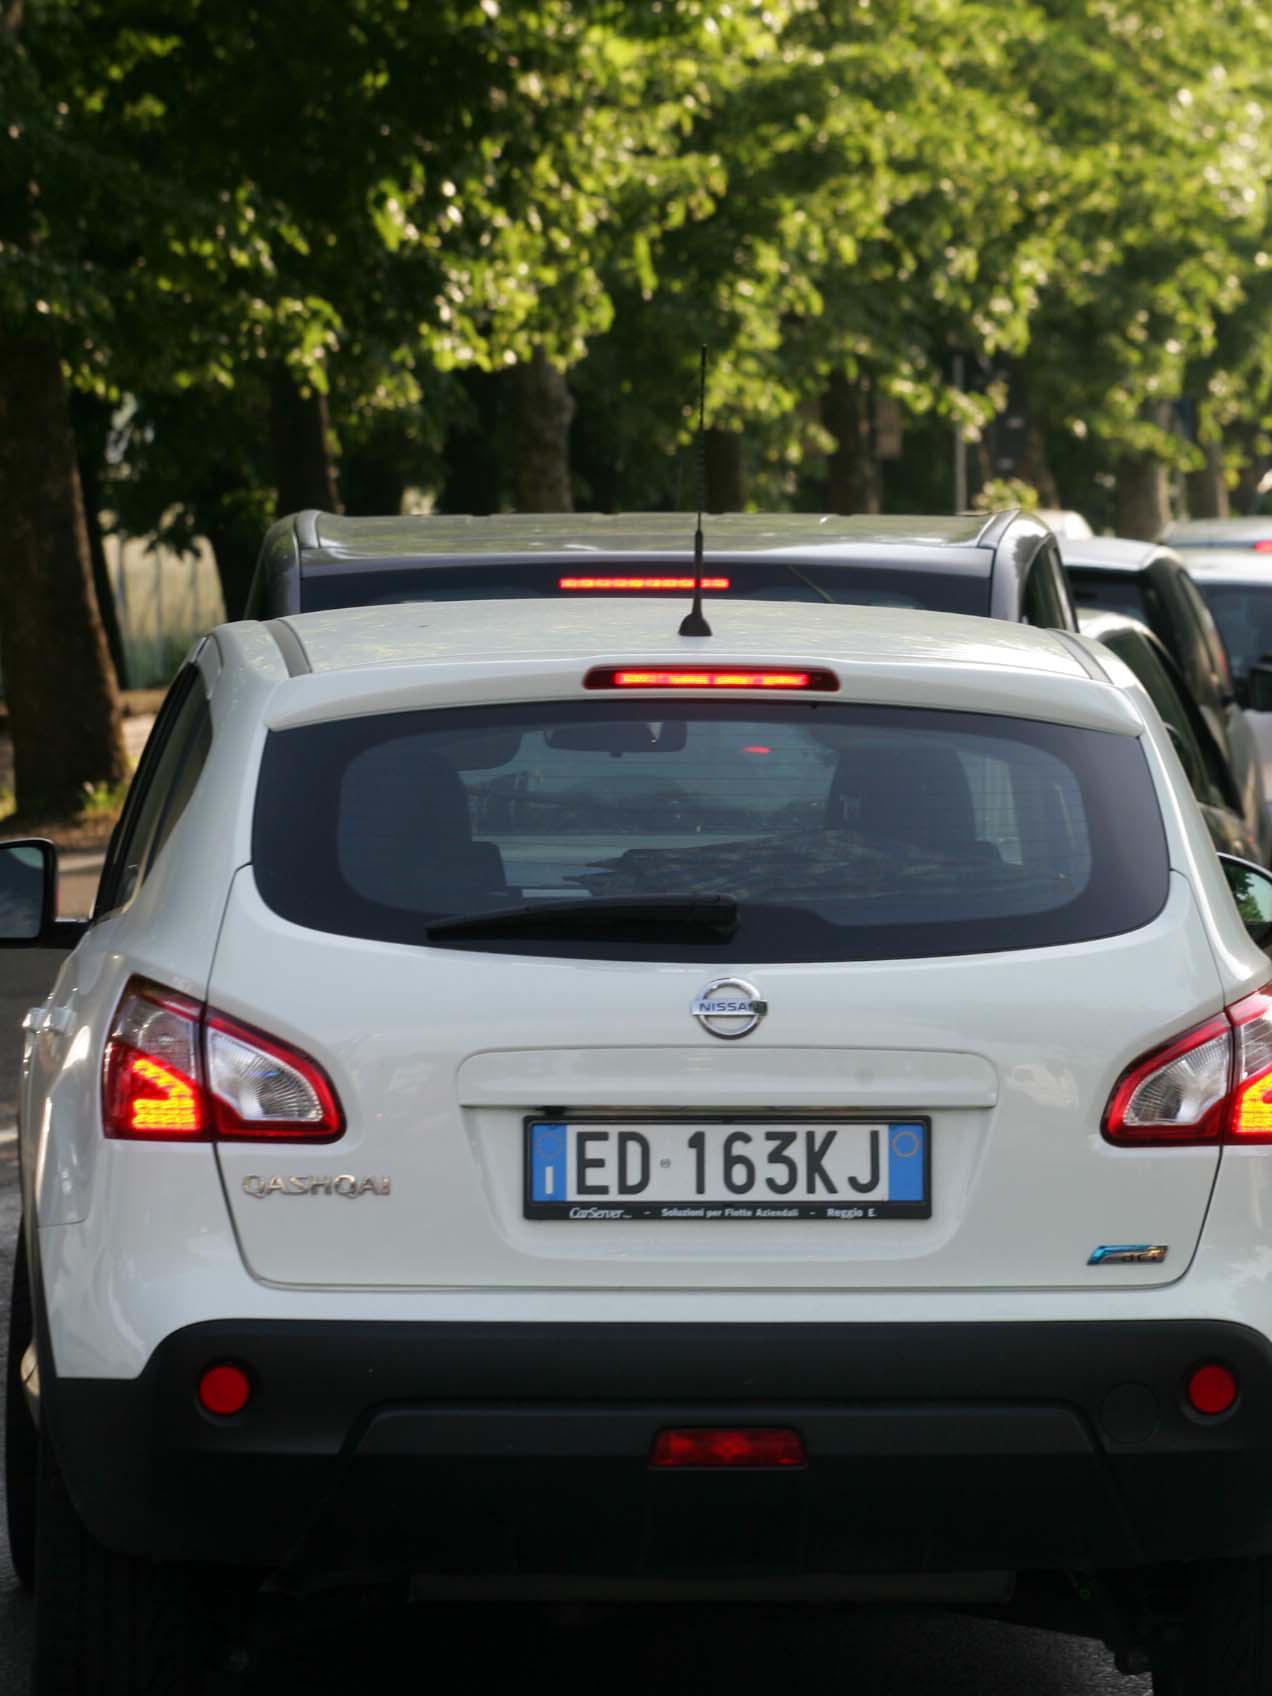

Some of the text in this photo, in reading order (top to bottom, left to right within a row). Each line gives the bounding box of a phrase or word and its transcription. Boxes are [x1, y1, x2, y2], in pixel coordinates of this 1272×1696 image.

[699, 1002, 761, 1012] NISSAN
[576, 1131, 650, 1195] ED
[688, 1131, 880, 1195] 163KJ
[243, 1175, 391, 1199] QASHQAI
[569, 1207, 624, 1219] CarServer
[661, 1207, 704, 1217] Soluzioni
[706, 1209, 721, 1219] per
[724, 1208, 752, 1217] Flotte
[755, 1208, 799, 1217] Aziendali
[827, 1207, 863, 1219] Reggio
